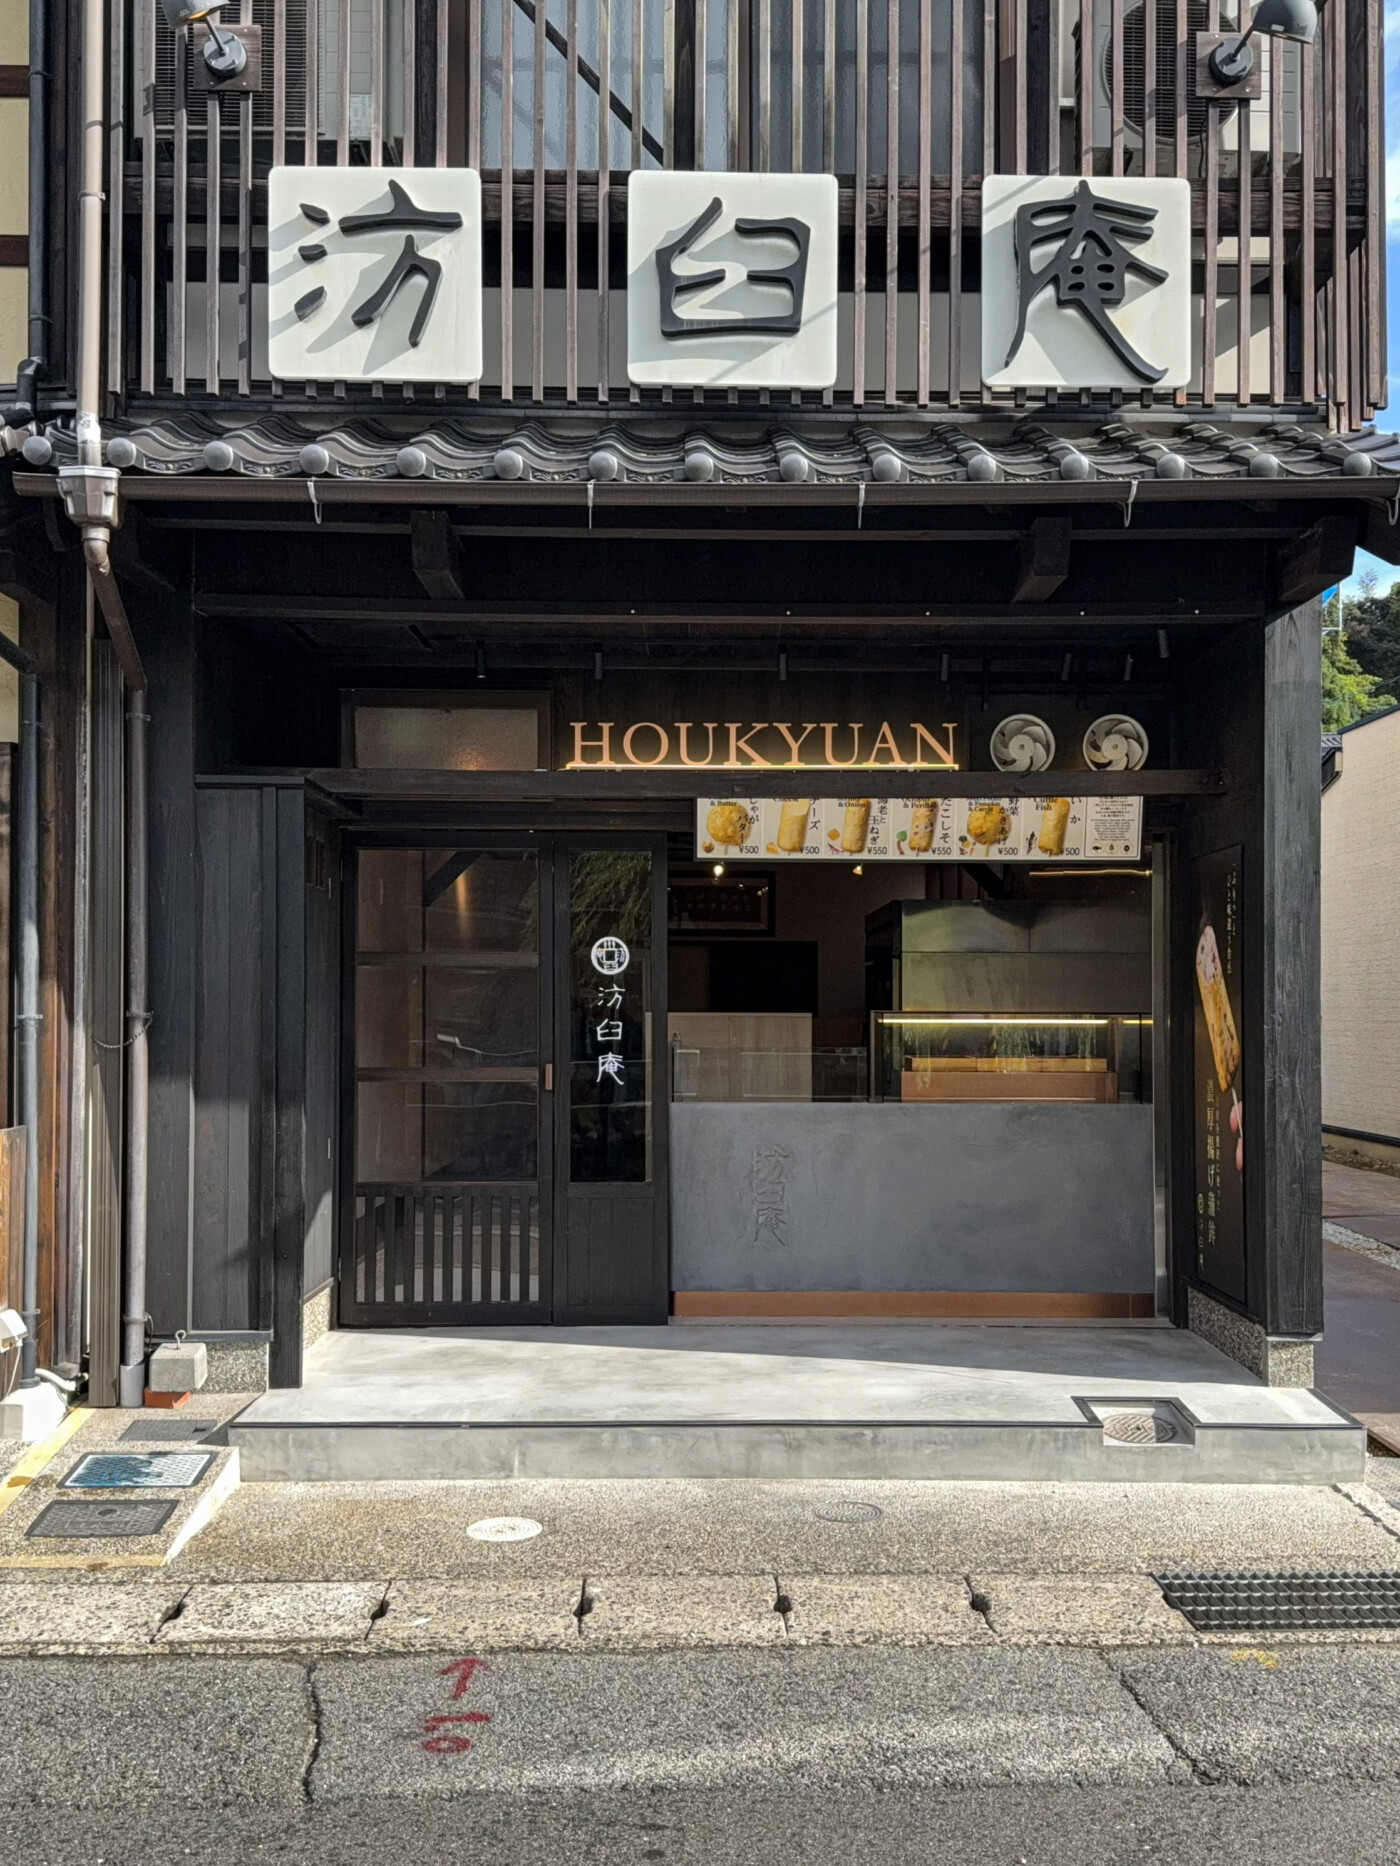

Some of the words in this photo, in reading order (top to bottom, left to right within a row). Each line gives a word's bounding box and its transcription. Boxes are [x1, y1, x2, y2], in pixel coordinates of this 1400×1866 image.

[570, 721, 958, 765] HOUKYUAN
[1035, 803, 1052, 811] Fish
[739, 846, 759, 854] ¥500
[799, 846, 819, 854] ¥500
[867, 847, 887, 855] ¥550
[932, 847, 951, 855] ¥550
[998, 847, 1018, 856] ¥500
